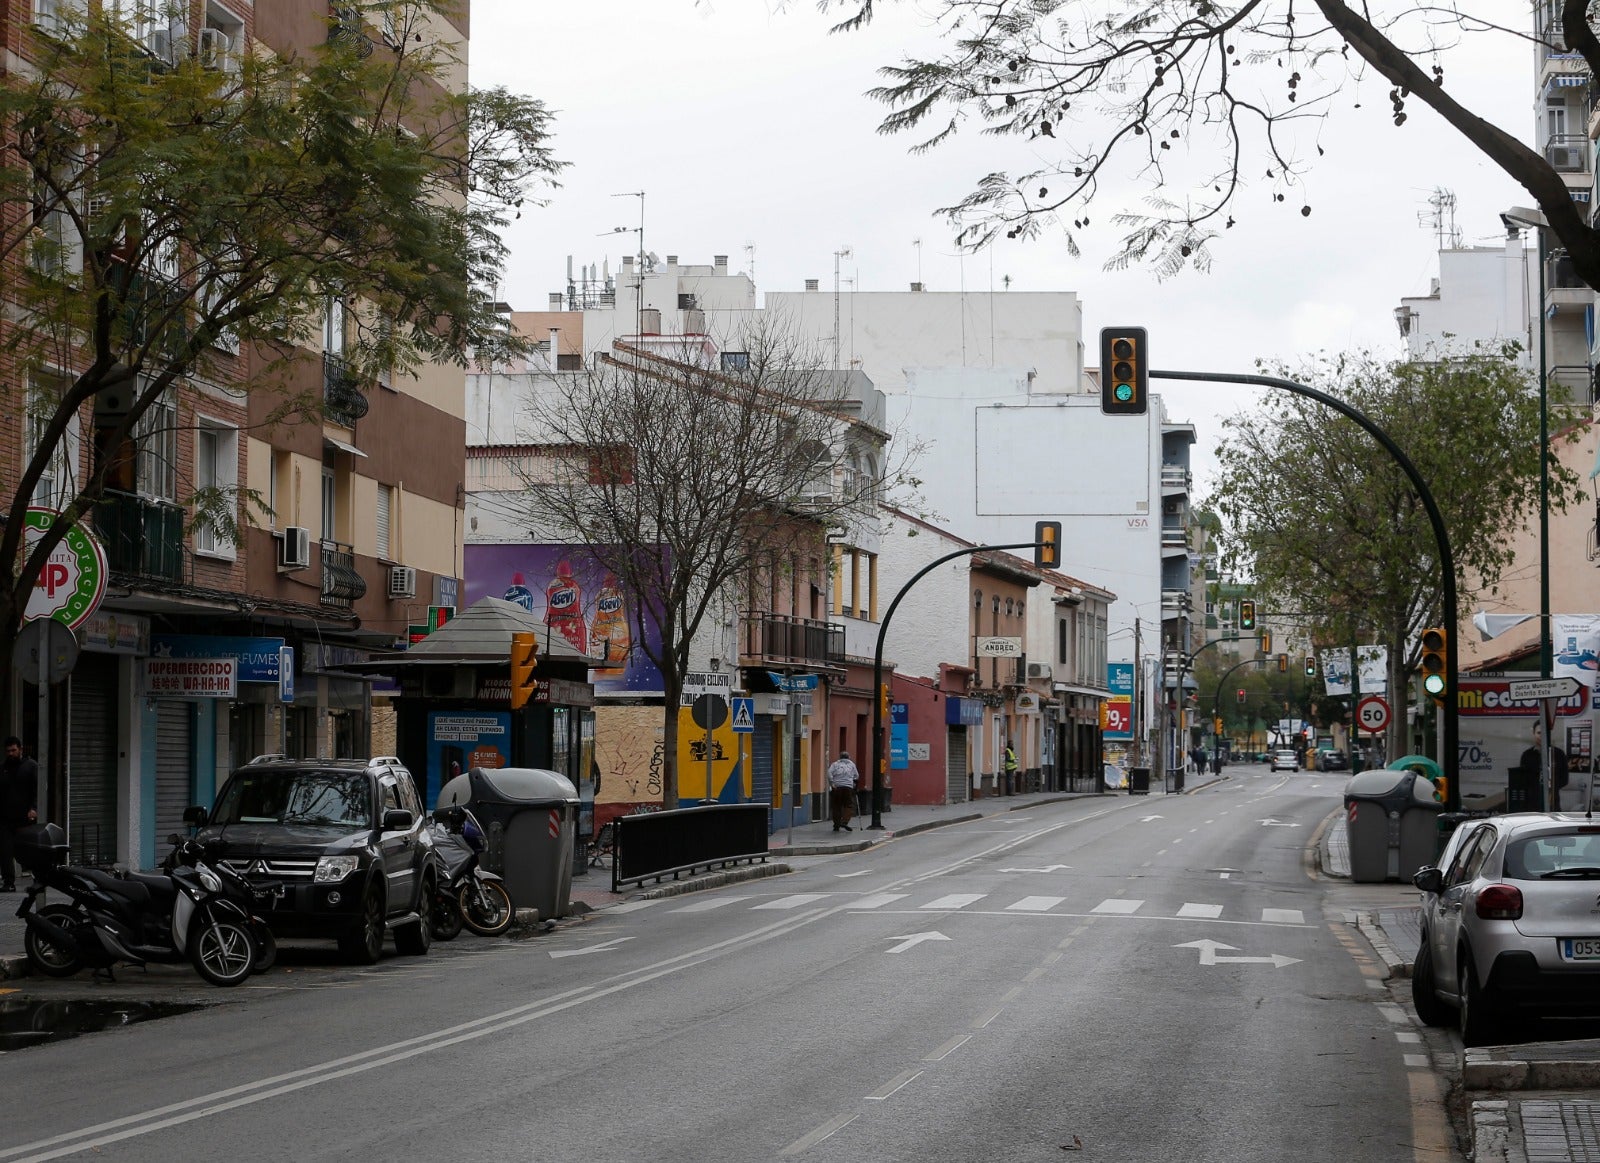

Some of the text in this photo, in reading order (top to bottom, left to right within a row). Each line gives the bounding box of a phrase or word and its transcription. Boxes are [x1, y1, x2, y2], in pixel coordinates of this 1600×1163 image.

[551, 588, 575, 605] Asevi
[599, 597, 620, 611] Asevi
[148, 662, 232, 675] SUPERMERCADO
[1116, 668, 1121, 679] 5
[152, 676, 180, 690] 娃哈哈
[1515, 682, 1557, 691] Junta Municipal
[1363, 710, 1383, 721] 50
[473, 751, 480, 760] 5
